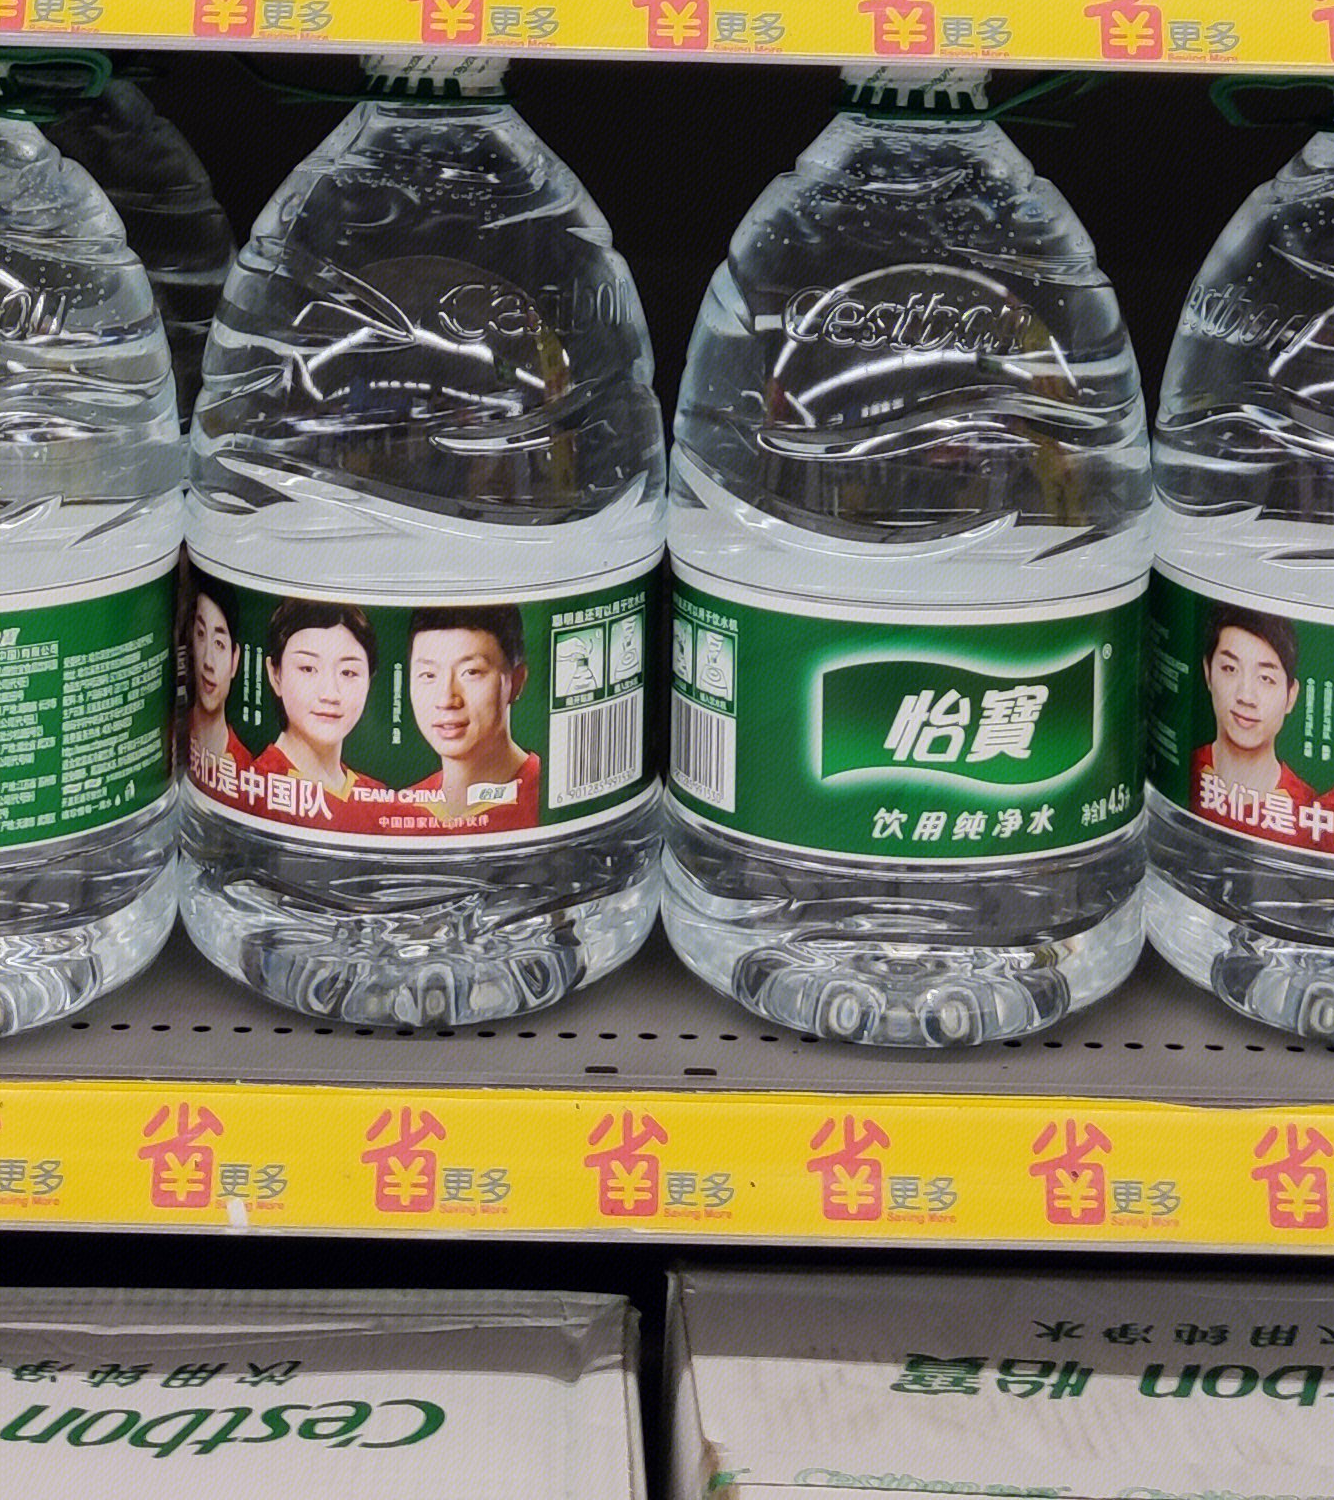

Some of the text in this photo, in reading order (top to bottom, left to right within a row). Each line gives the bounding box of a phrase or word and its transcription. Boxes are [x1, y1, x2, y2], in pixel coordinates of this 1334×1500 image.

[487, 5, 559, 40] 更多
[940, 16, 1012, 48] 更多
[351, 786, 447, 803] TEAM CHINA
[871, 803, 1057, 843] 饮用纯净水
[140, 1105, 288, 1208] 省 更多
[363, 1108, 511, 1212] 省 更多
[585, 1112, 735, 1217] 省 更多
[1030, 1121, 1181, 1225] 省 更多
